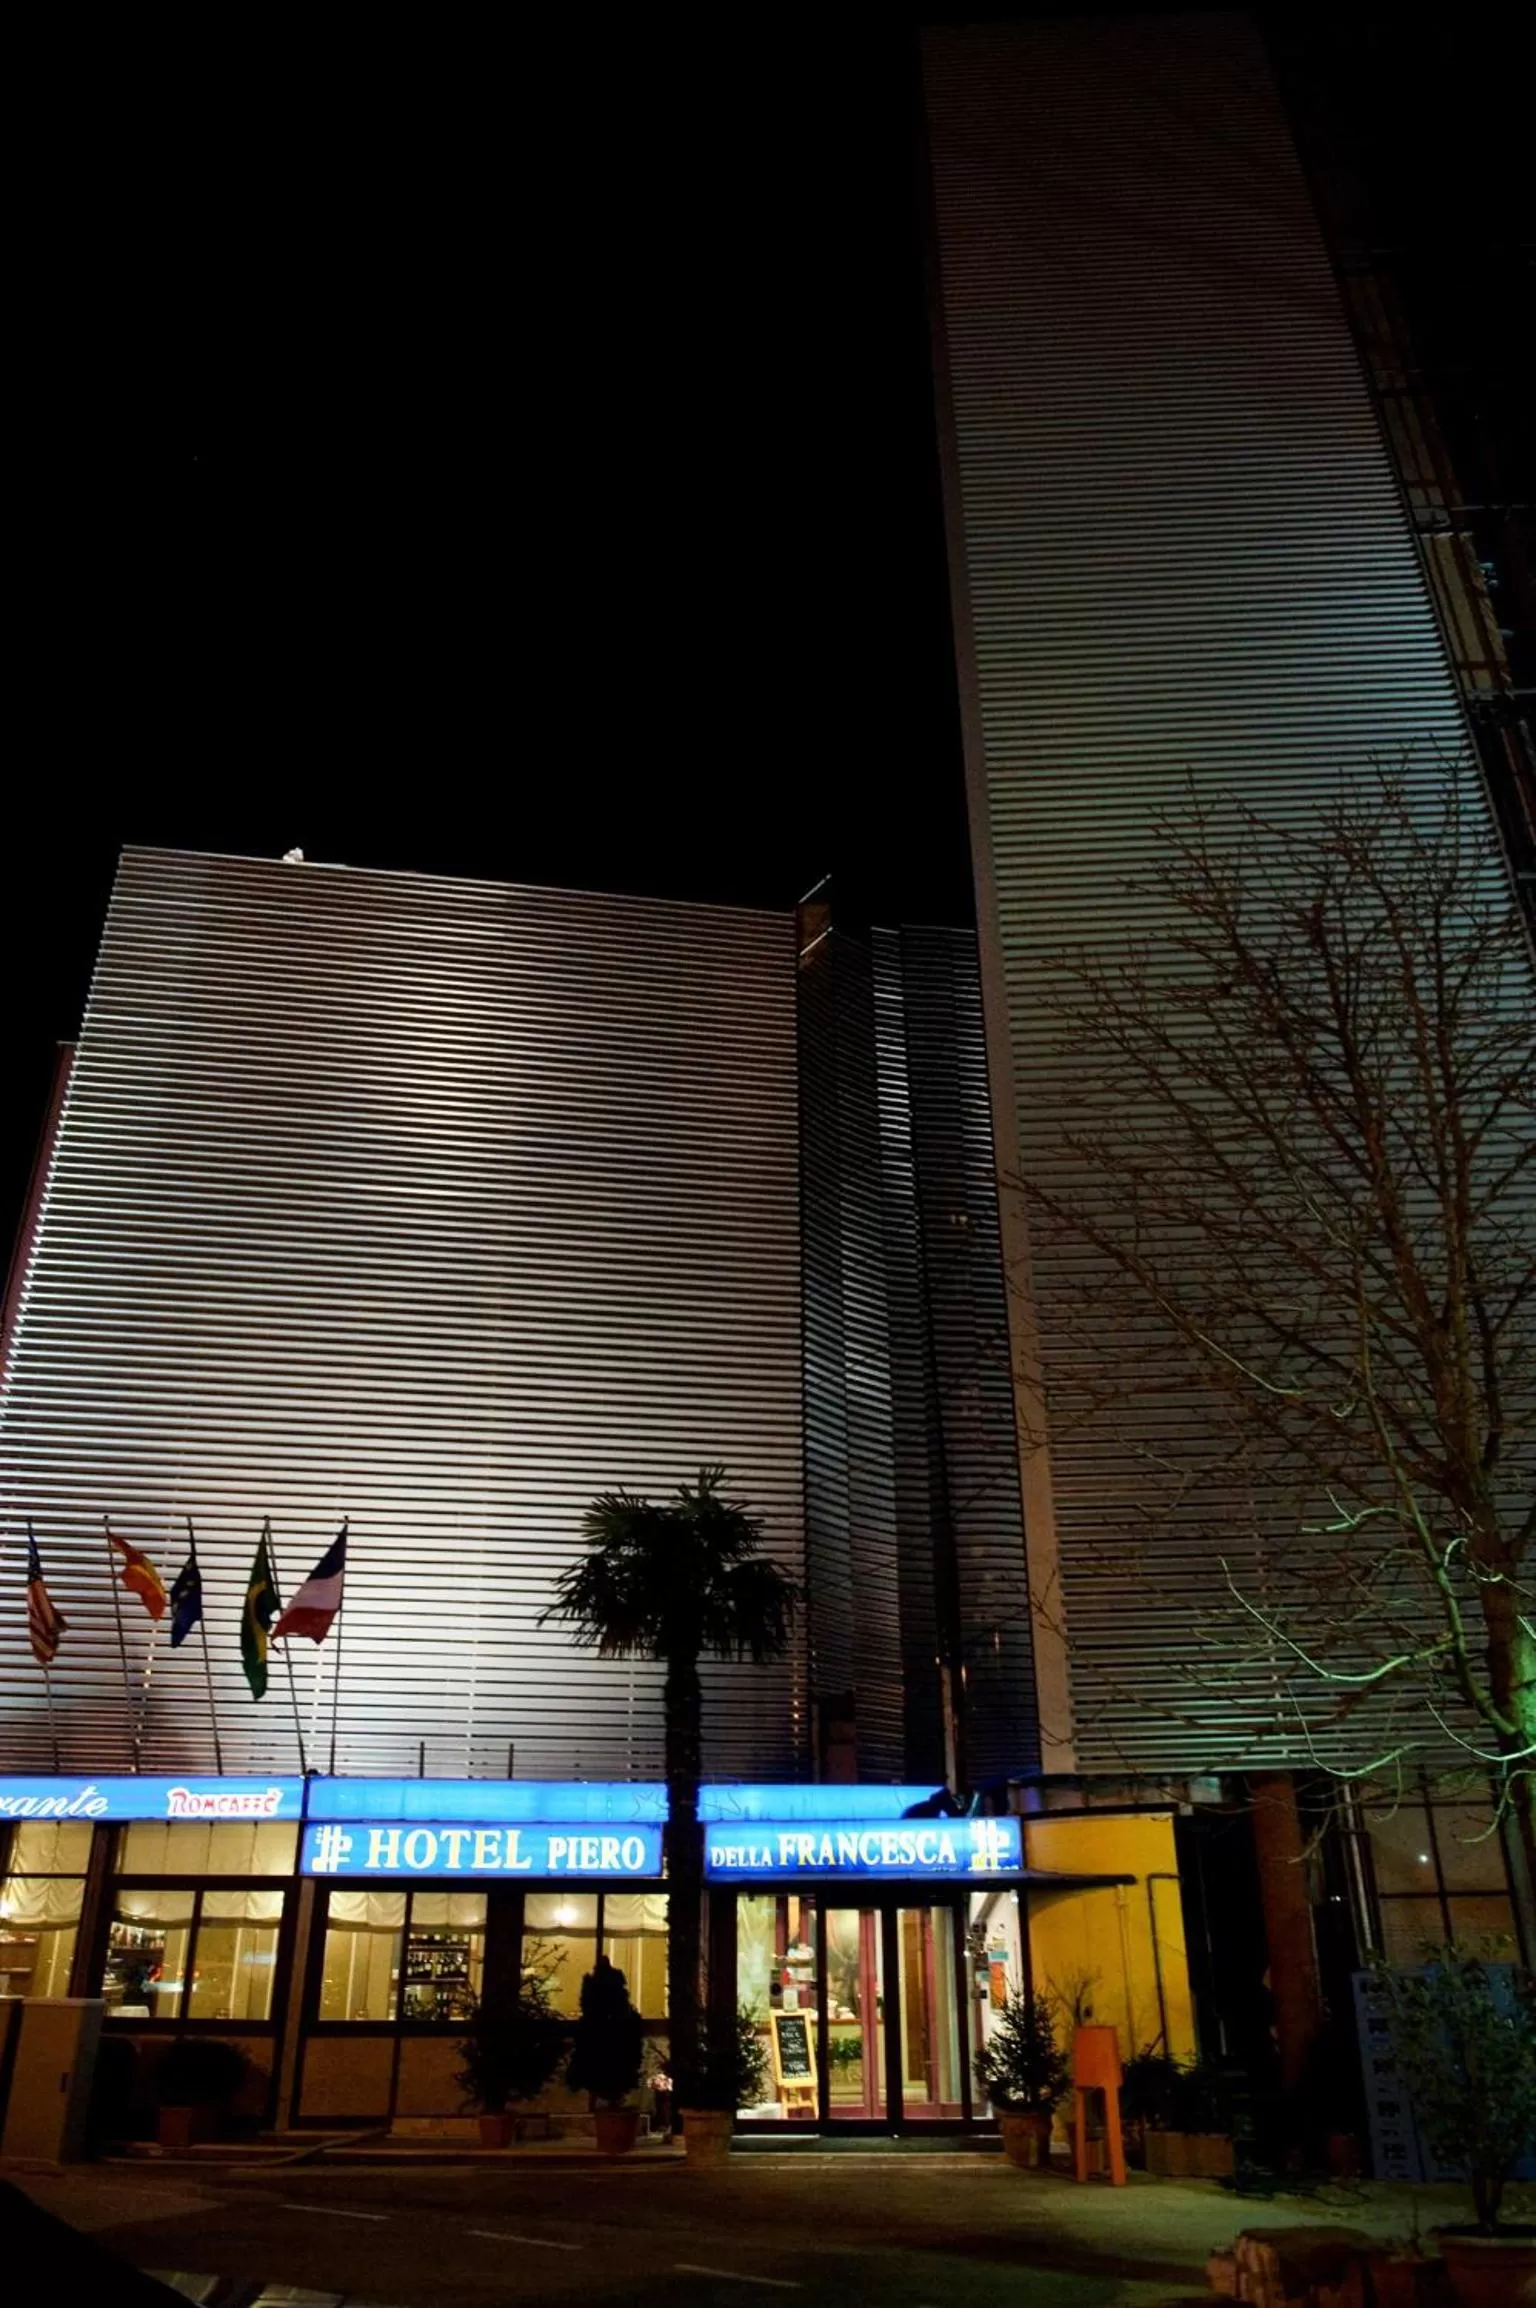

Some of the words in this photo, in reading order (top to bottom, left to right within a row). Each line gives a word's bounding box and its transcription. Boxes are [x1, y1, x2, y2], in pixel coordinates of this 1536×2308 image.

[364, 1829, 532, 1869] HOTEL
[547, 1837, 646, 1870] PIERO
[710, 1846, 773, 1867] DELLA
[776, 1832, 957, 1866] FRANCESCA
